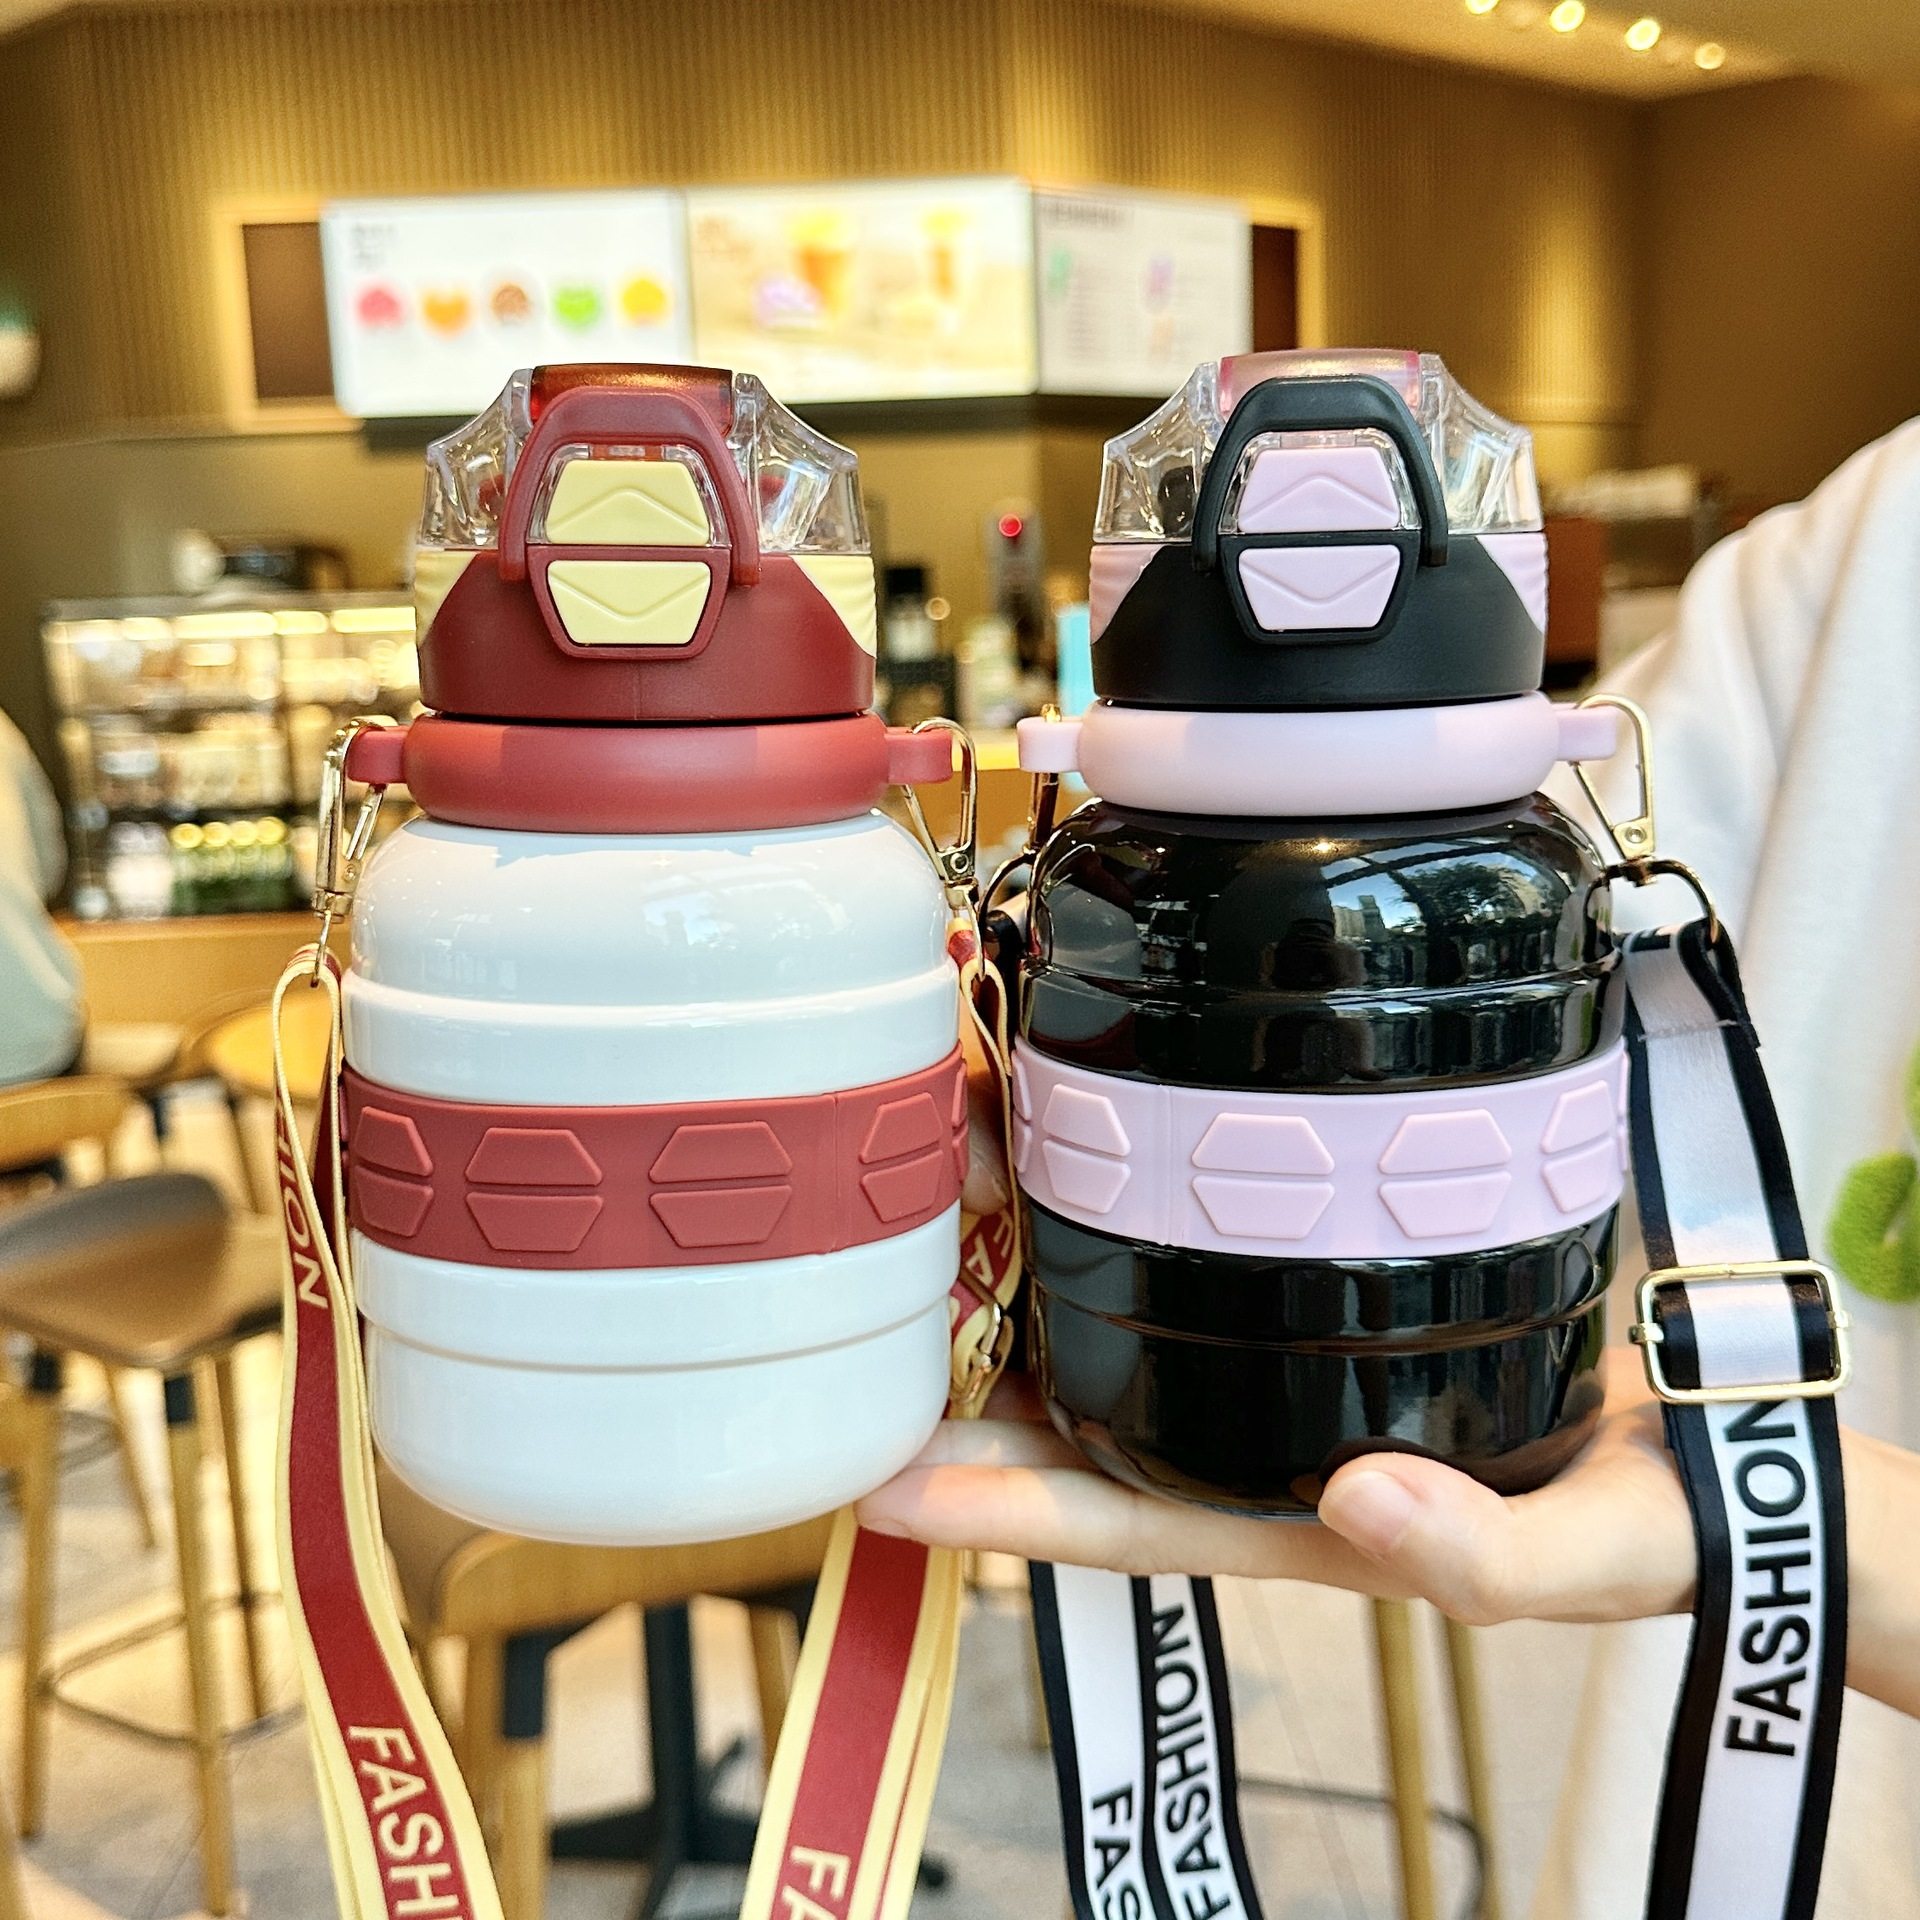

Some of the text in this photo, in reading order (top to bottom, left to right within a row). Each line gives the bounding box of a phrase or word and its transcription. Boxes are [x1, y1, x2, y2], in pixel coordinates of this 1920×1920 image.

[1724, 1399, 1811, 1756] FASHION
[348, 1725, 464, 1920] FASH
[1150, 1603, 1231, 1920] FASHION
